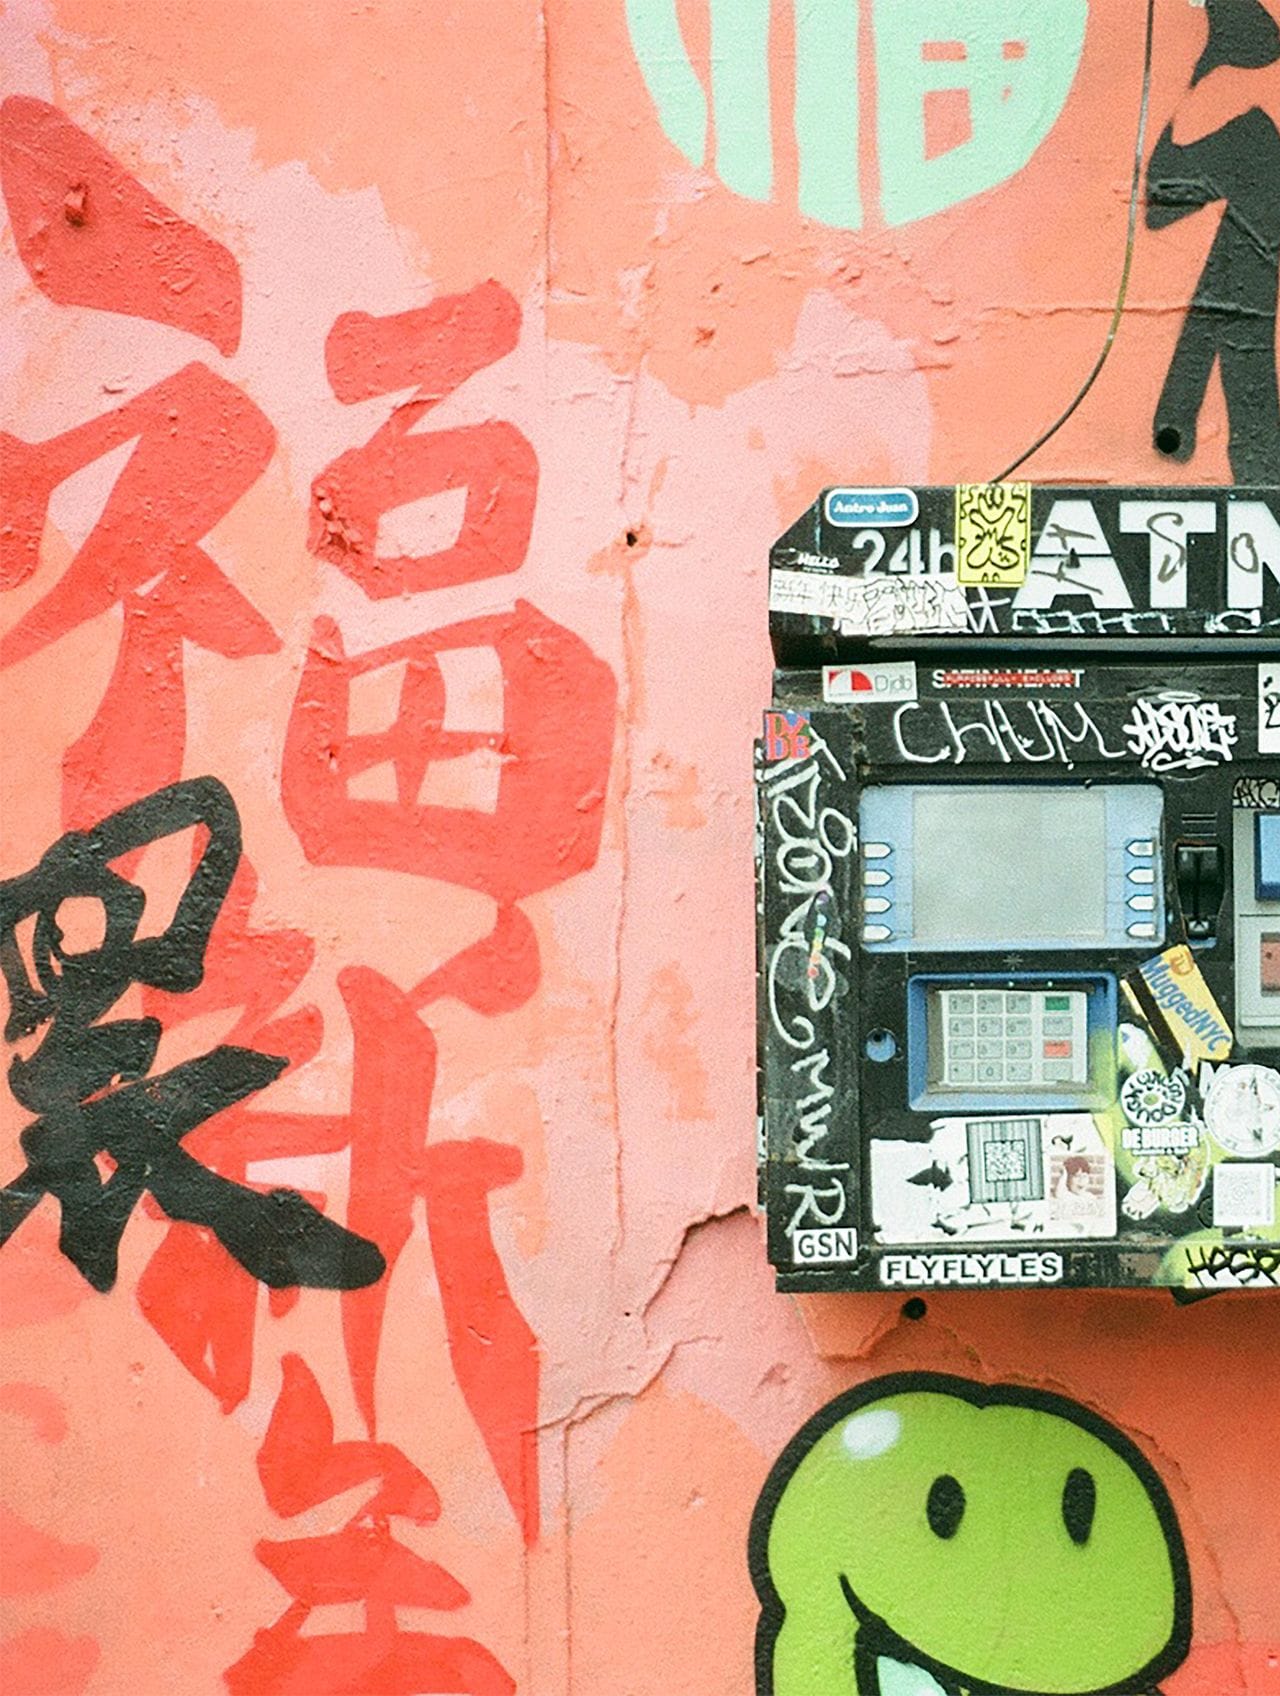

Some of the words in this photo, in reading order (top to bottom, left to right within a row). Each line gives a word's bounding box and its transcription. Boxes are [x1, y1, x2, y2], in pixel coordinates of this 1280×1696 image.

[1138, 955, 1231, 1053] MuggedNYC
[798, 1232, 853, 1258] GSN
[886, 1256, 1060, 1280] FLYFLYLES
